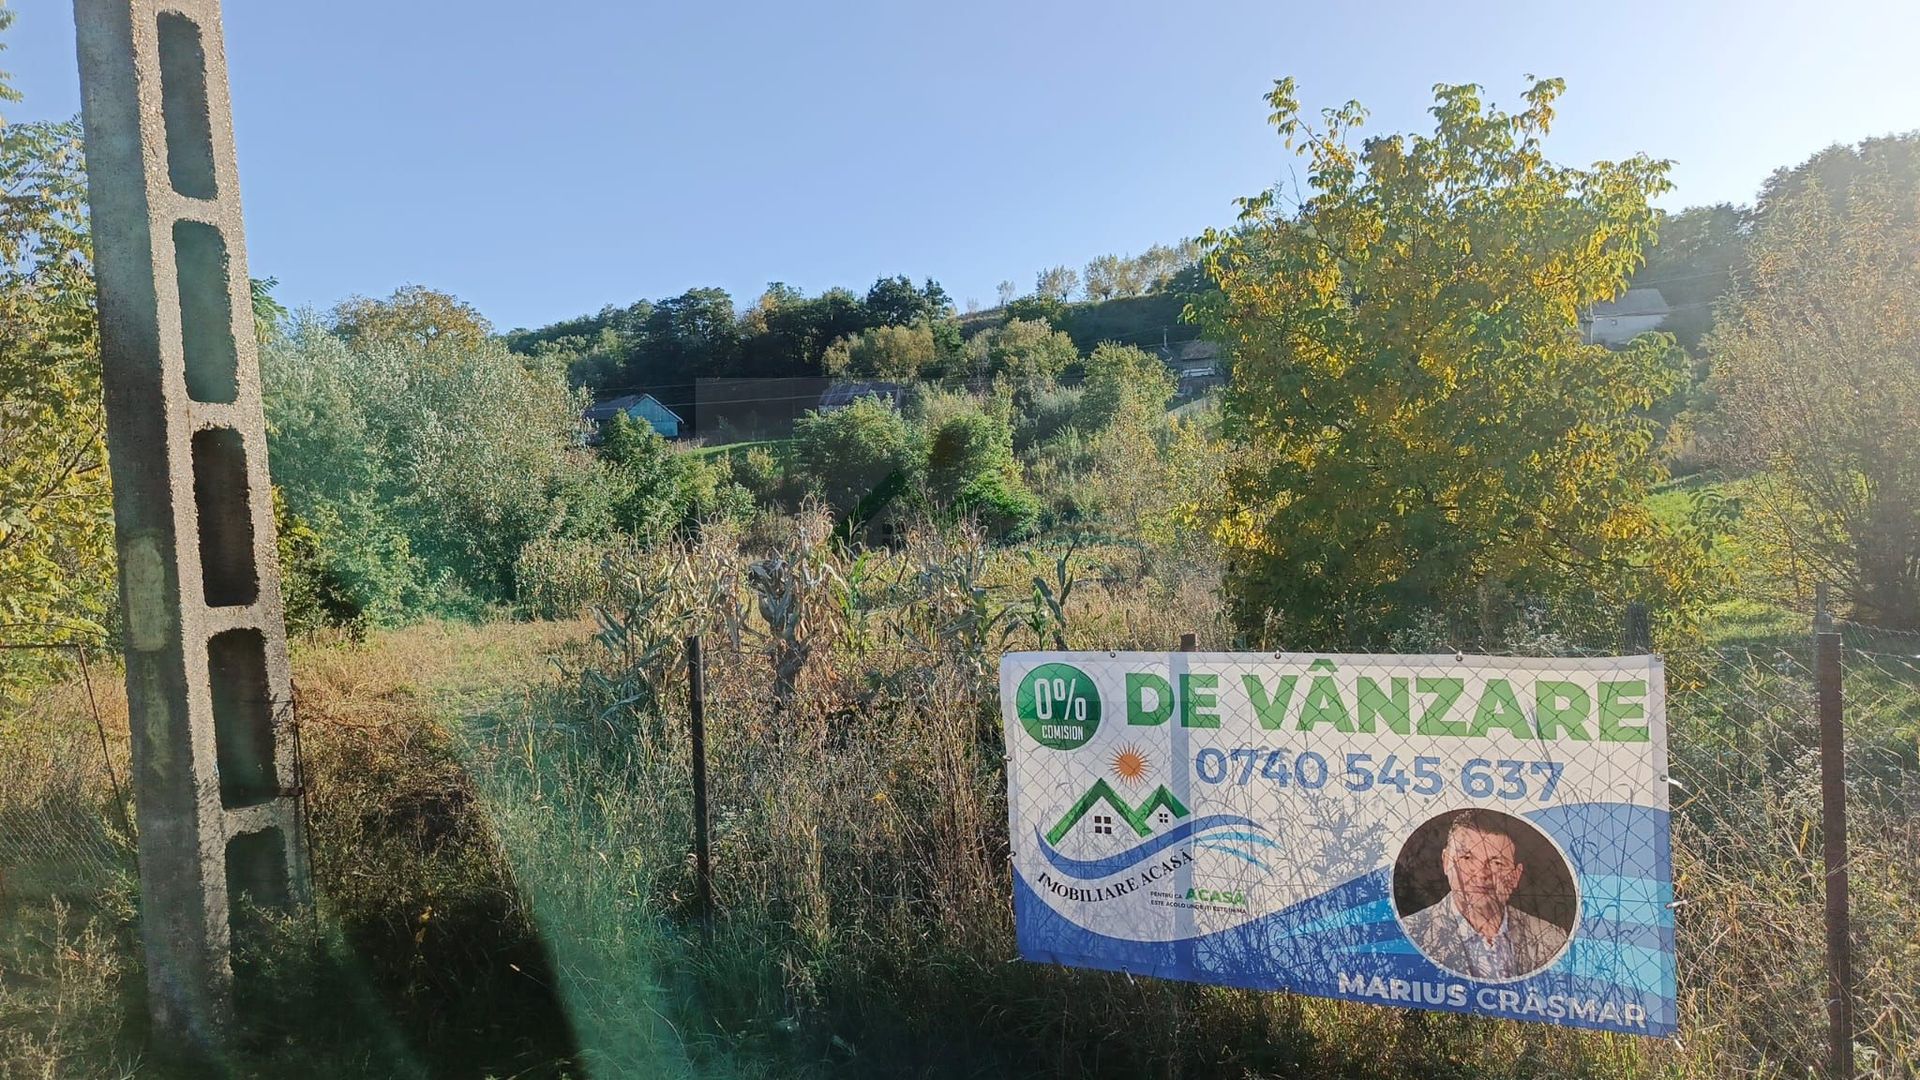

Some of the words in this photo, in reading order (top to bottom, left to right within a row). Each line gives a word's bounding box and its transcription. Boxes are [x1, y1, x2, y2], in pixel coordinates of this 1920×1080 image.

[1033, 678, 1087, 721] 0%
[1125, 672, 1221, 729] DE
[1241, 658, 1650, 742] VÂNZARE
[1041, 724, 1084, 741] COMISION
[1195, 747, 1328, 790] 0740
[1345, 753, 1443, 796] 545
[1460, 758, 1565, 802] 637
[1037, 872, 1139, 903] IMOBILIARE
[1150, 891, 1174, 899] PENTRU
[1338, 971, 1468, 1007] MARIUS
